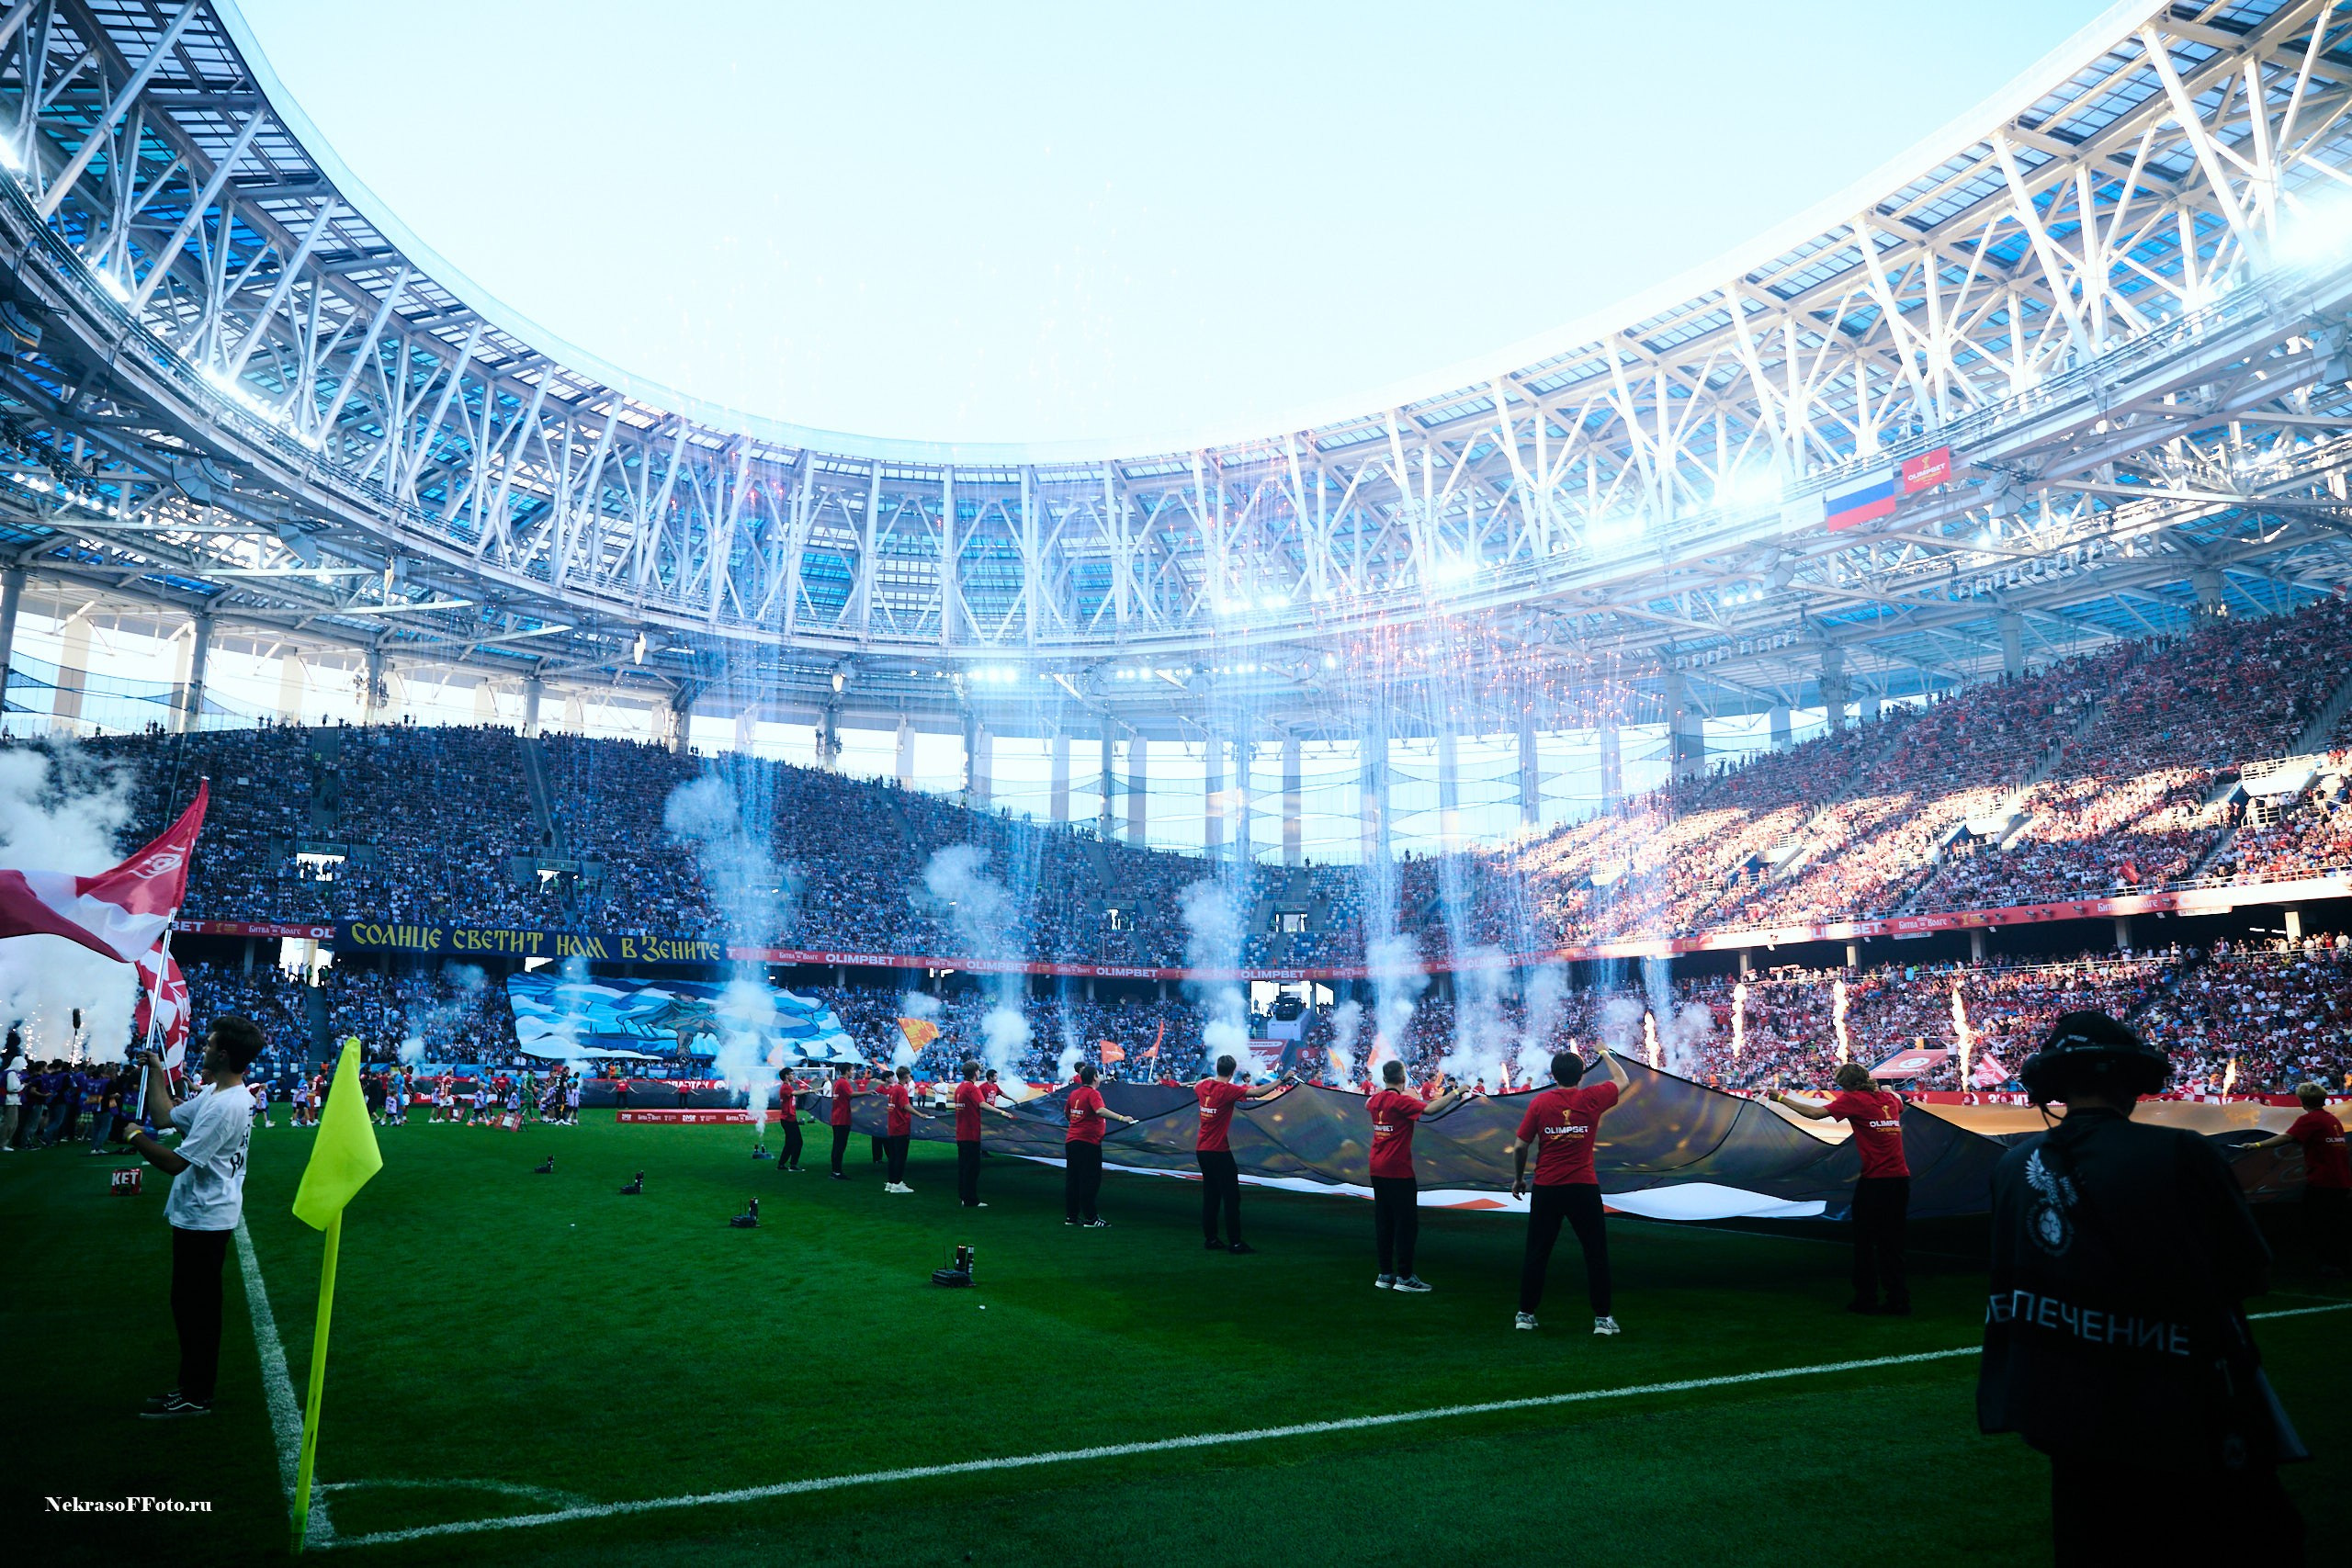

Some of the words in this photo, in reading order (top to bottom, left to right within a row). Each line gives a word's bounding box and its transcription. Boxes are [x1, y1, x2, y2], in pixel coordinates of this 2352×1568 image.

[351, 922, 443, 952] СОЛНЦЕ
[452, 929, 544, 953] СВЕТИТ
[556, 934, 609, 959] НАМ
[641, 936, 720, 962] ЗЕНИТЕ
[825, 953, 895, 964] OLIMPBET
[967, 960, 1030, 972] OLIMPBET
[1096, 967, 1159, 977] OLIMPBET
[1240, 969, 1306, 979] OLIMPBET
